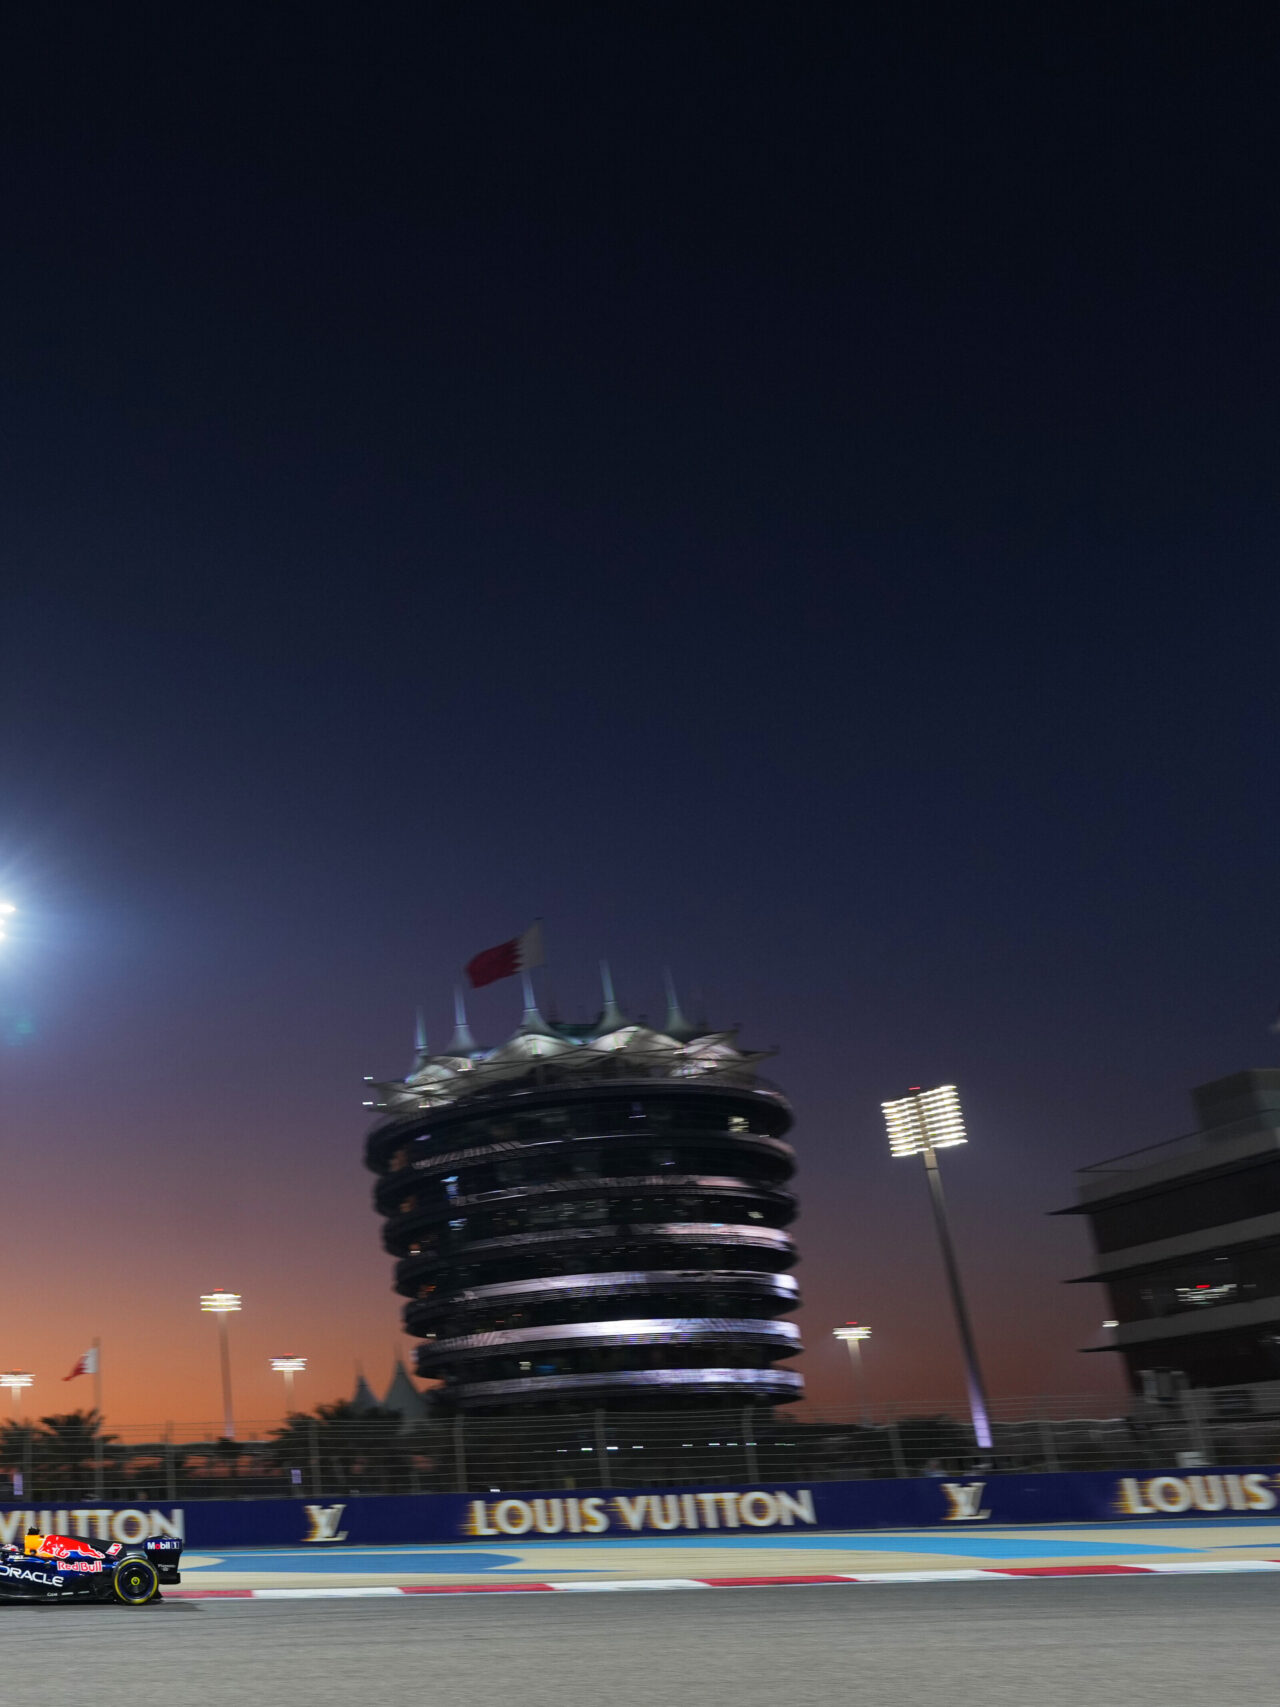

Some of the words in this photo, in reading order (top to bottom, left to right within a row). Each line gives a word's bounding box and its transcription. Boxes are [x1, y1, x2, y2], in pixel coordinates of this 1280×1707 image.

[1119, 1473, 1277, 1514] LOUIS
[468, 1497, 609, 1535] LOUIS
[615, 1490, 817, 1531] VUITTON
[147, 1541, 171, 1550] Mobil
[57, 1560, 79, 1572] Red
[80, 1560, 103, 1573] Bull
